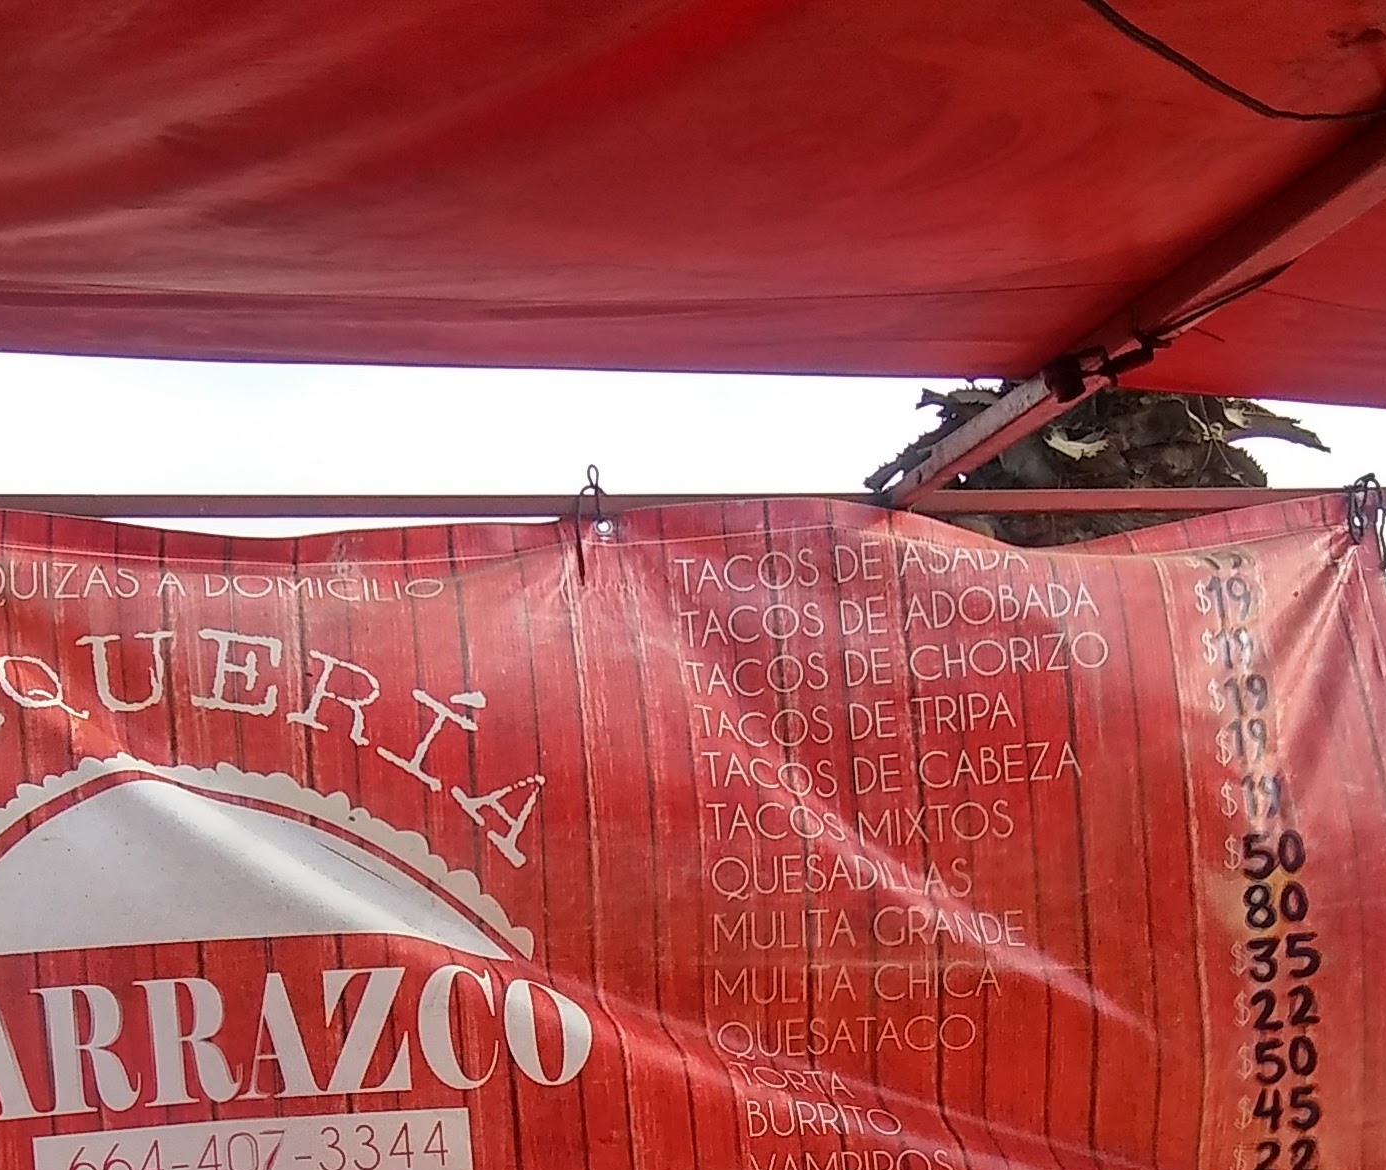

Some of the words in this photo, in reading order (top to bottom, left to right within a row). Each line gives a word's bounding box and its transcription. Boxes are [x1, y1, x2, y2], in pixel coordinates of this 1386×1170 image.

[157, 571, 186, 599] A
[204, 572, 445, 602] DOMICILIO
[673, 549, 820, 594] TACOS
[835, 541, 882, 584] DE
[679, 602, 824, 648] TACOS
[839, 595, 888, 635] DE
[904, 581, 1100, 633] ADOBADA
[685, 653, 829, 698] TACOS
[844, 647, 892, 687] DE
[909, 630, 1109, 683] CHORIZO
[693, 704, 833, 748] TACOS
[849, 699, 898, 741] DE
[910, 692, 1017, 736] TRIPA
[701, 751, 838, 799] TACOS
[853, 752, 903, 796] DE
[918, 740, 1084, 789] CABEZA
[706, 801, 846, 842] TACOS
[858, 799, 1015, 847] MIXTOS
[711, 853, 973, 901] QUESADILLAS
[713, 907, 857, 952] MULITA
[872, 904, 1027, 948] GRANDE
[713, 963, 857, 1006] MULITA
[873, 960, 1002, 1001] CHICA
[716, 1013, 977, 1061] QUESATACO
[728, 1060, 856, 1099] TORTA
[745, 1099, 903, 1138] BURRITO
